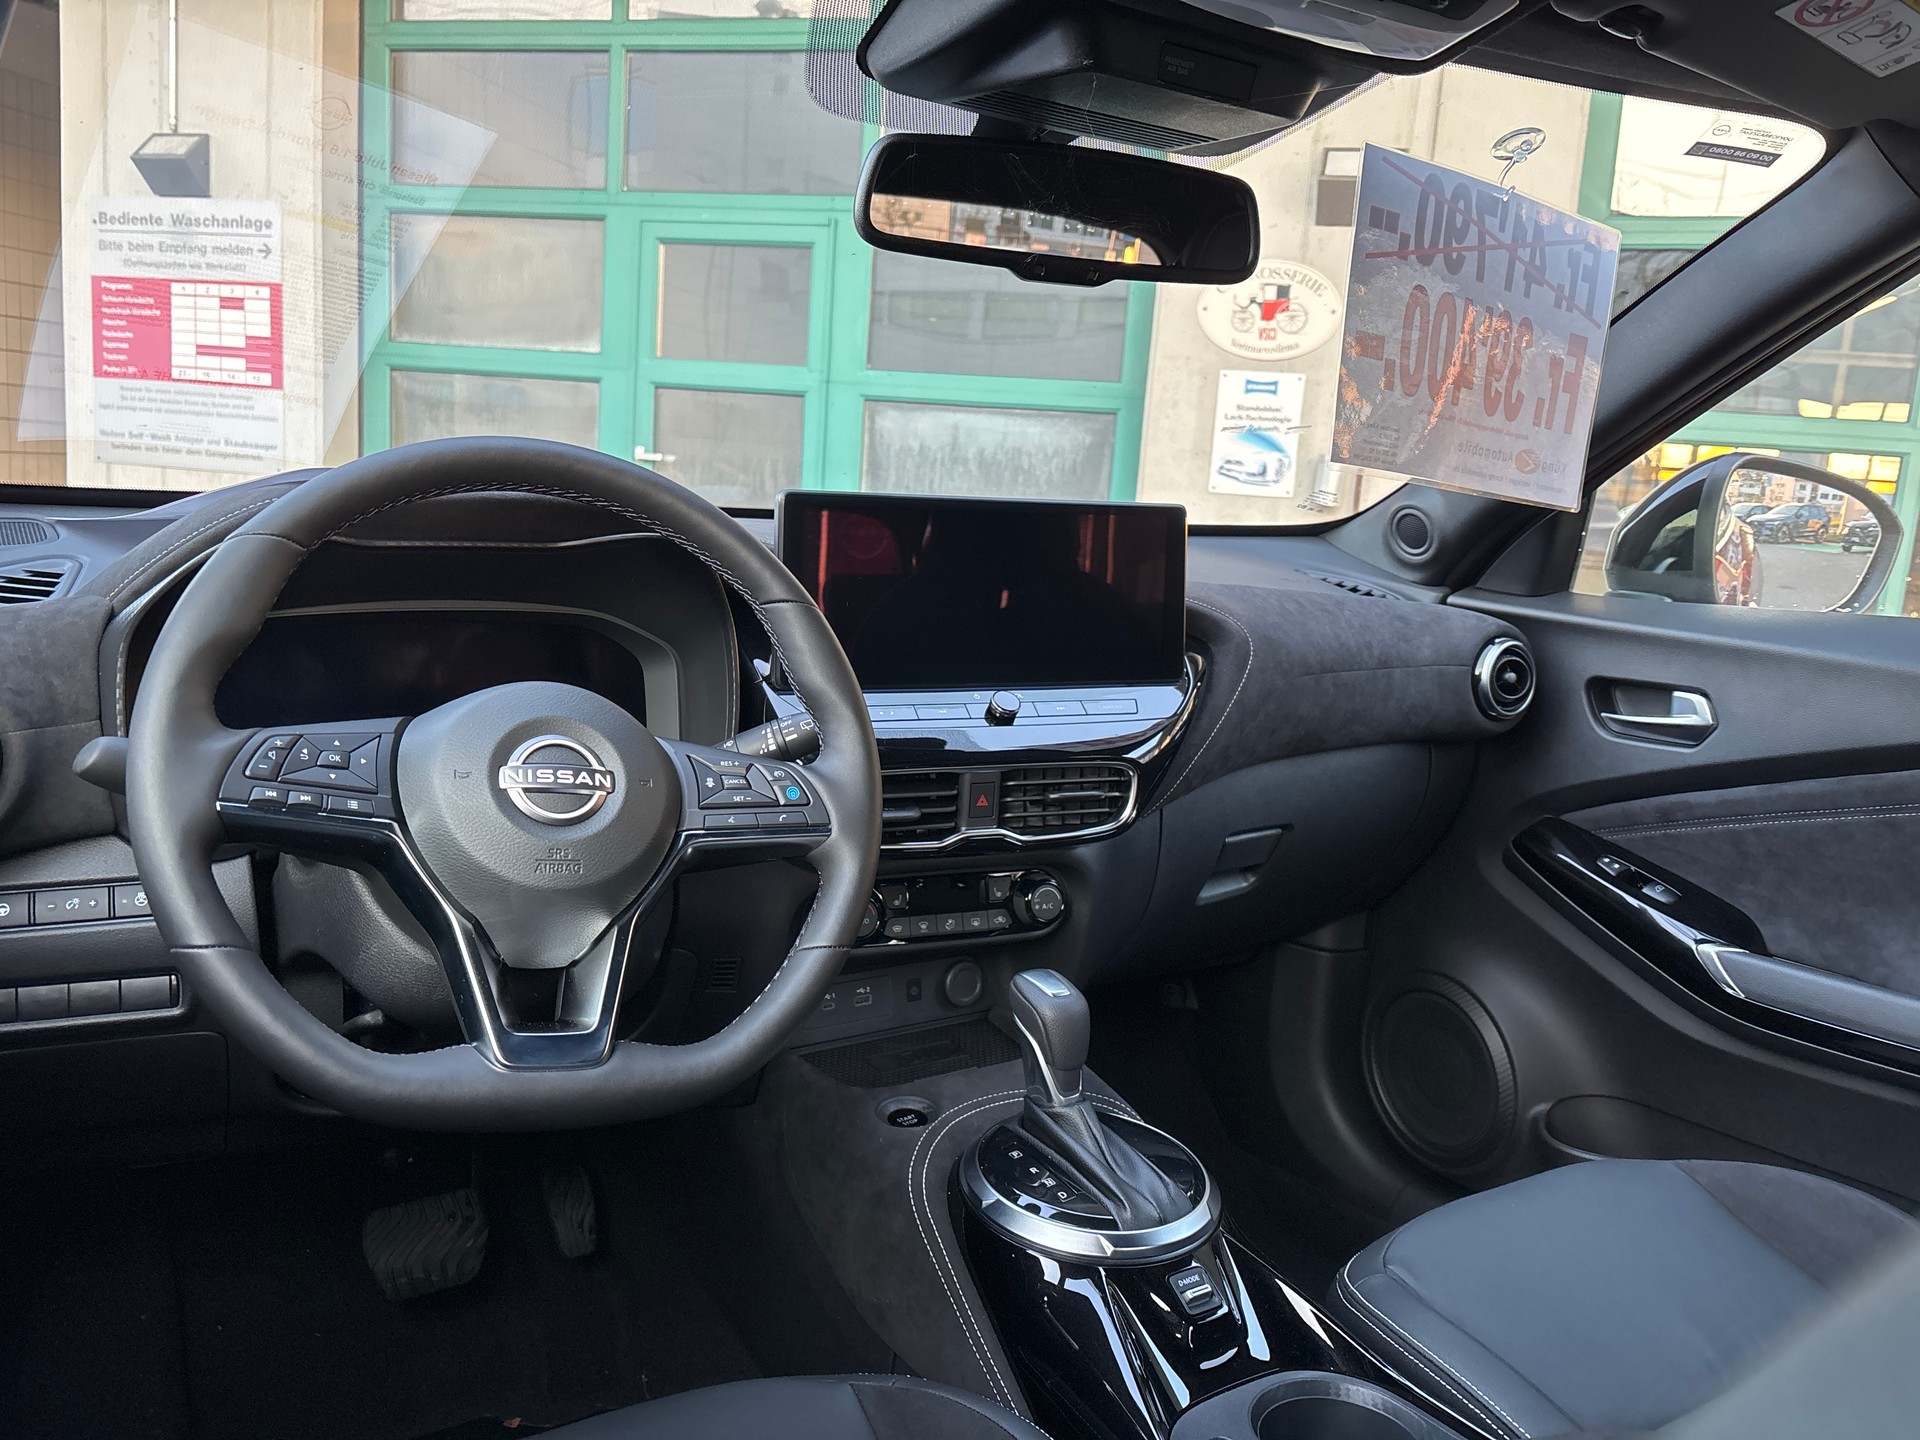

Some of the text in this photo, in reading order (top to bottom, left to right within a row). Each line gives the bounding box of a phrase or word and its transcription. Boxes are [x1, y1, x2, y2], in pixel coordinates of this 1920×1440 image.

[1708, 147, 1734, 155] 0800
[1734, 149, 1747, 157] 86
[98, 211, 273, 232] Bediente Waschanlage
[98, 240, 254, 257] Bitte beim Empfang melden
[780, 719, 793, 728] OFF
[328, 753, 342, 763] OK
[504, 768, 612, 789] NISSAN
[547, 848, 572, 860] SRS
[534, 862, 584, 875] AIRBAG
[1041, 902, 1054, 910] A/C
[896, 1113, 916, 1124] START
[901, 1118, 918, 1126] STOP
[1029, 1166, 1040, 1175] R
[1057, 1191, 1068, 1199] D
[1177, 1274, 1200, 1287] D-MODE
